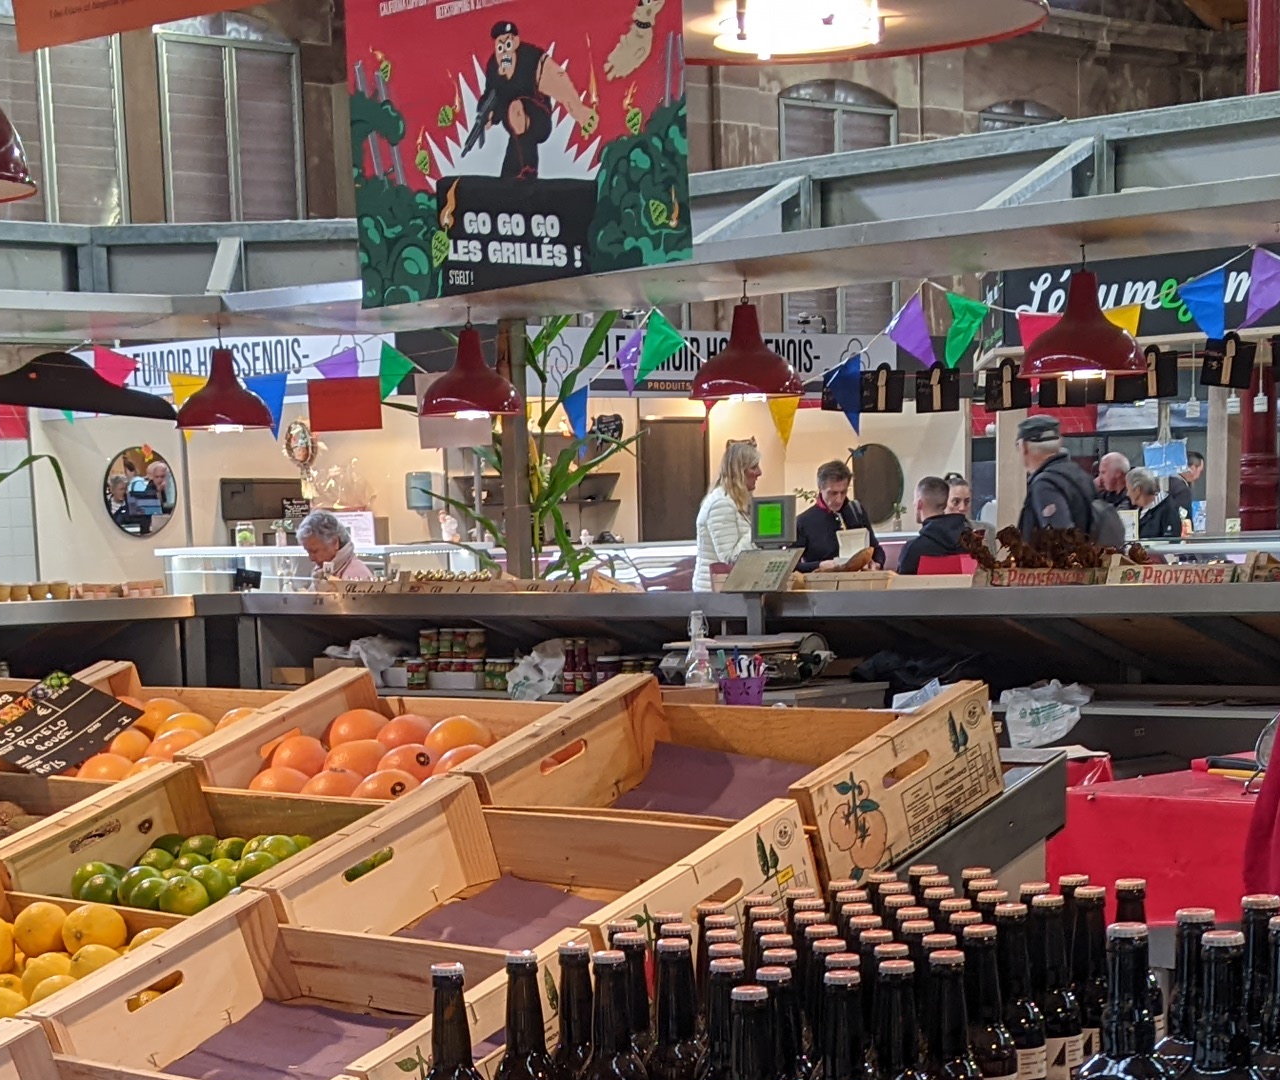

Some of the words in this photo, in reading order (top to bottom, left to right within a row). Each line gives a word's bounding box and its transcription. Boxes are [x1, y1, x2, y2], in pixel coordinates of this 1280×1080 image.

[463, 211, 492, 235] GO
[497, 213, 525, 236] GO
[531, 214, 560, 238] GO
[448, 239, 482, 263] LES
[487, 237, 568, 268] GRILLÉS
[573, 245, 582, 269] !
[133, 345, 193, 387] FUMOIR
[647, 380, 693, 392] PRODUITS
[1141, 564, 1226, 585] PROVENCE
[35, 703, 53, 717] €
[16, 718, 68, 749] POMELO
[34, 725, 74, 752] ROUGE
